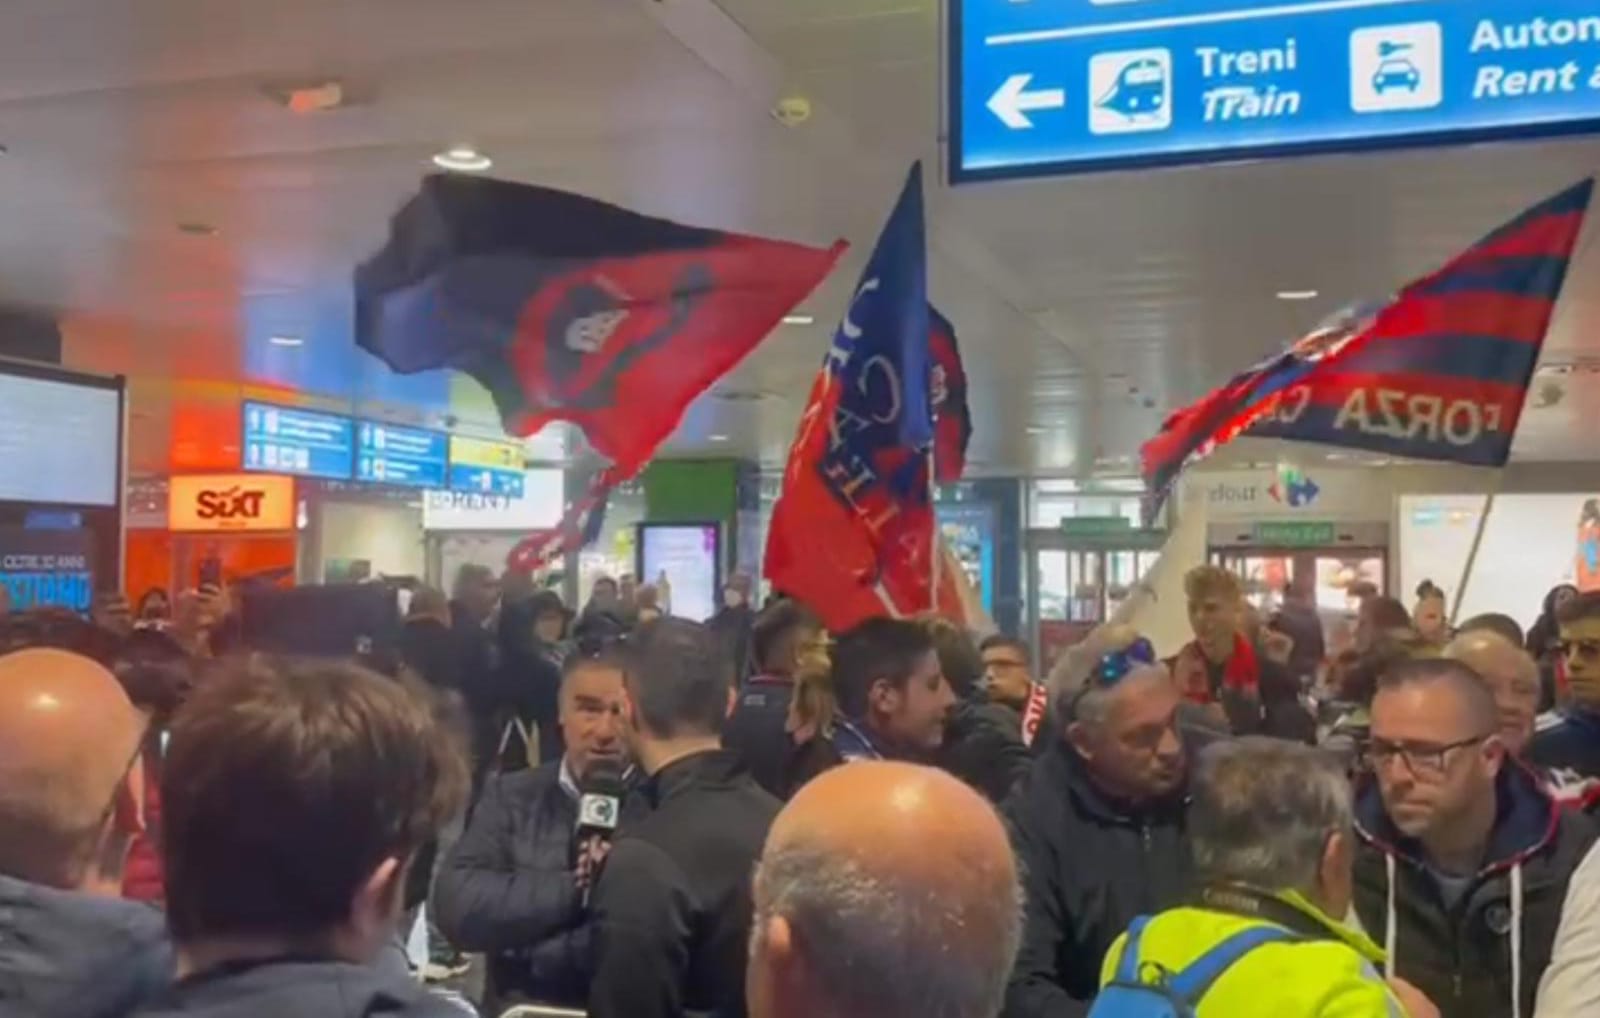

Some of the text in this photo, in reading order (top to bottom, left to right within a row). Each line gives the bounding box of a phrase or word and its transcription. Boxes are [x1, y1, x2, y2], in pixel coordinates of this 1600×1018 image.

[1195, 38, 1296, 76] Treni
[1472, 60, 1579, 99] Rent
[1203, 84, 1300, 121] Train
